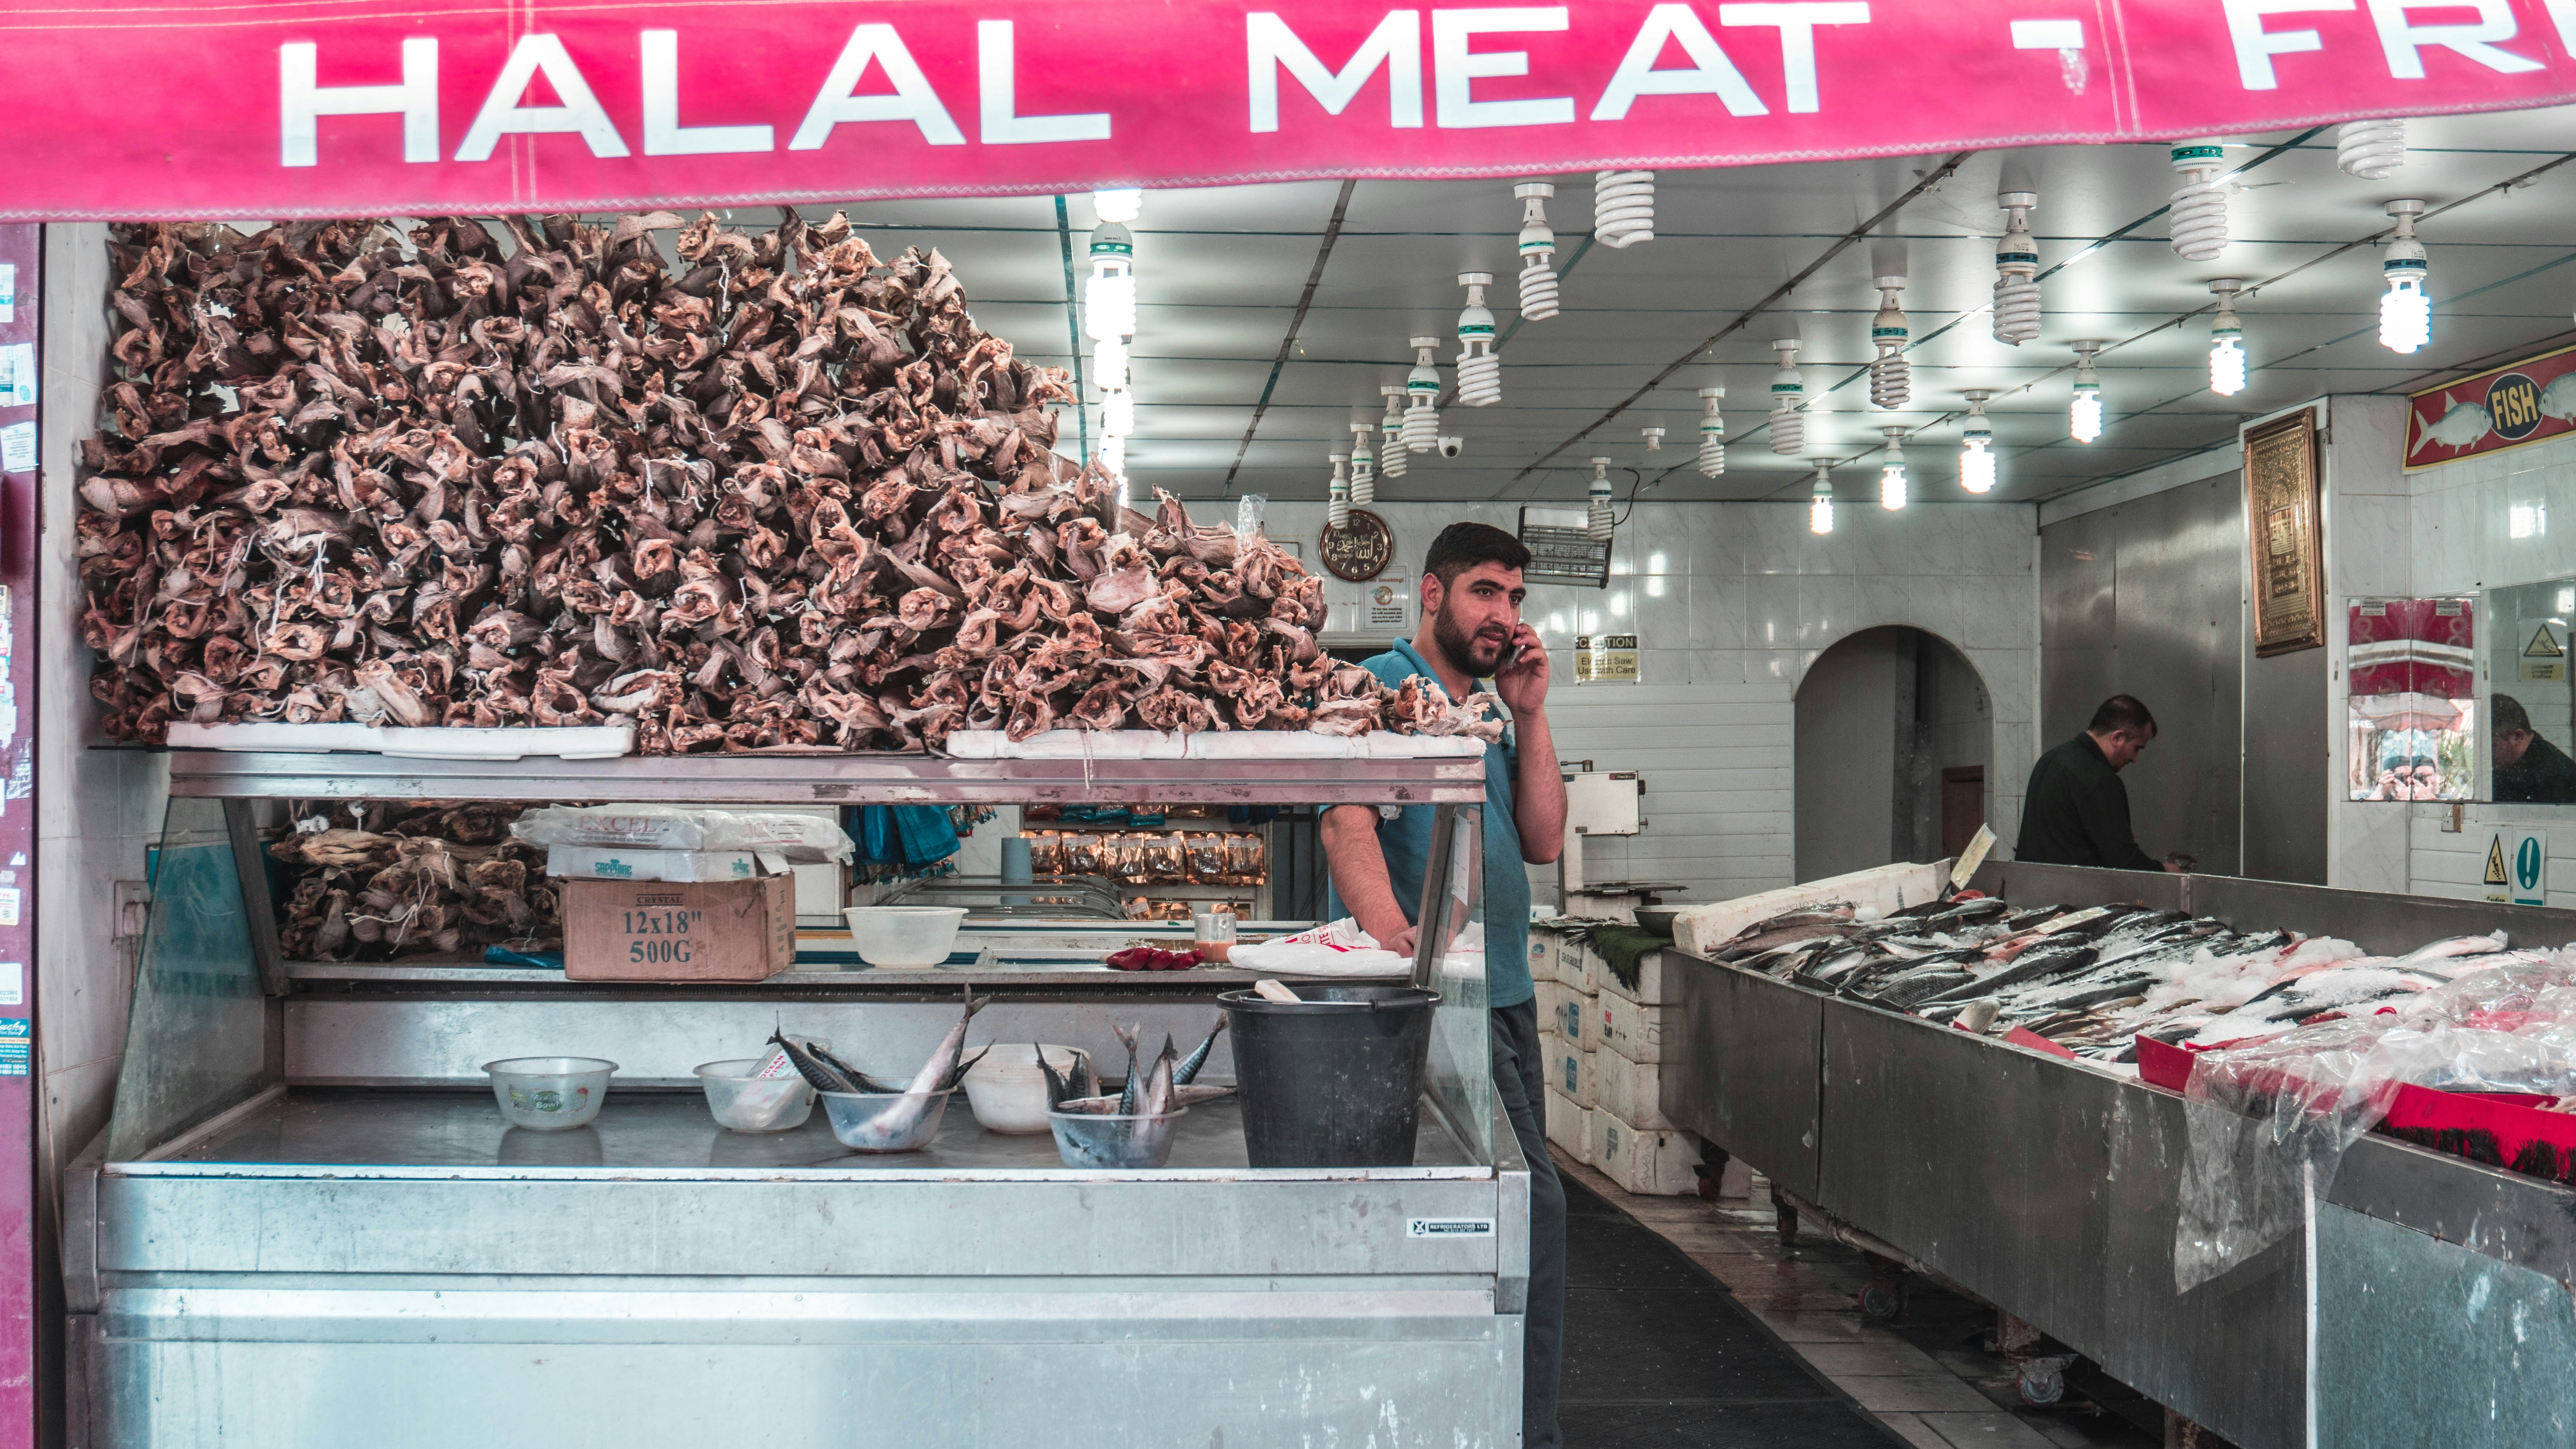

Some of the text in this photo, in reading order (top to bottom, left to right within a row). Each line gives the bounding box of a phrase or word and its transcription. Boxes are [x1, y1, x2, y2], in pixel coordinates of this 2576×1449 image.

[281, 20, 1111, 166] HALAL
[1247, 1, 1870, 132] MEAT
[2222, 0, 2576, 90] FR
[2491, 382, 2538, 430] FISH
[579, 816, 657, 833] EXCEL
[595, 862, 632, 875] SAPPHIRE
[636, 896, 683, 905] CRYSTAL
[623, 910, 702, 934] 12x18"
[630, 940, 691, 963] 500G
[760, 1055, 784, 1078] OCEAN
[769, 1061, 786, 1078] FISH
